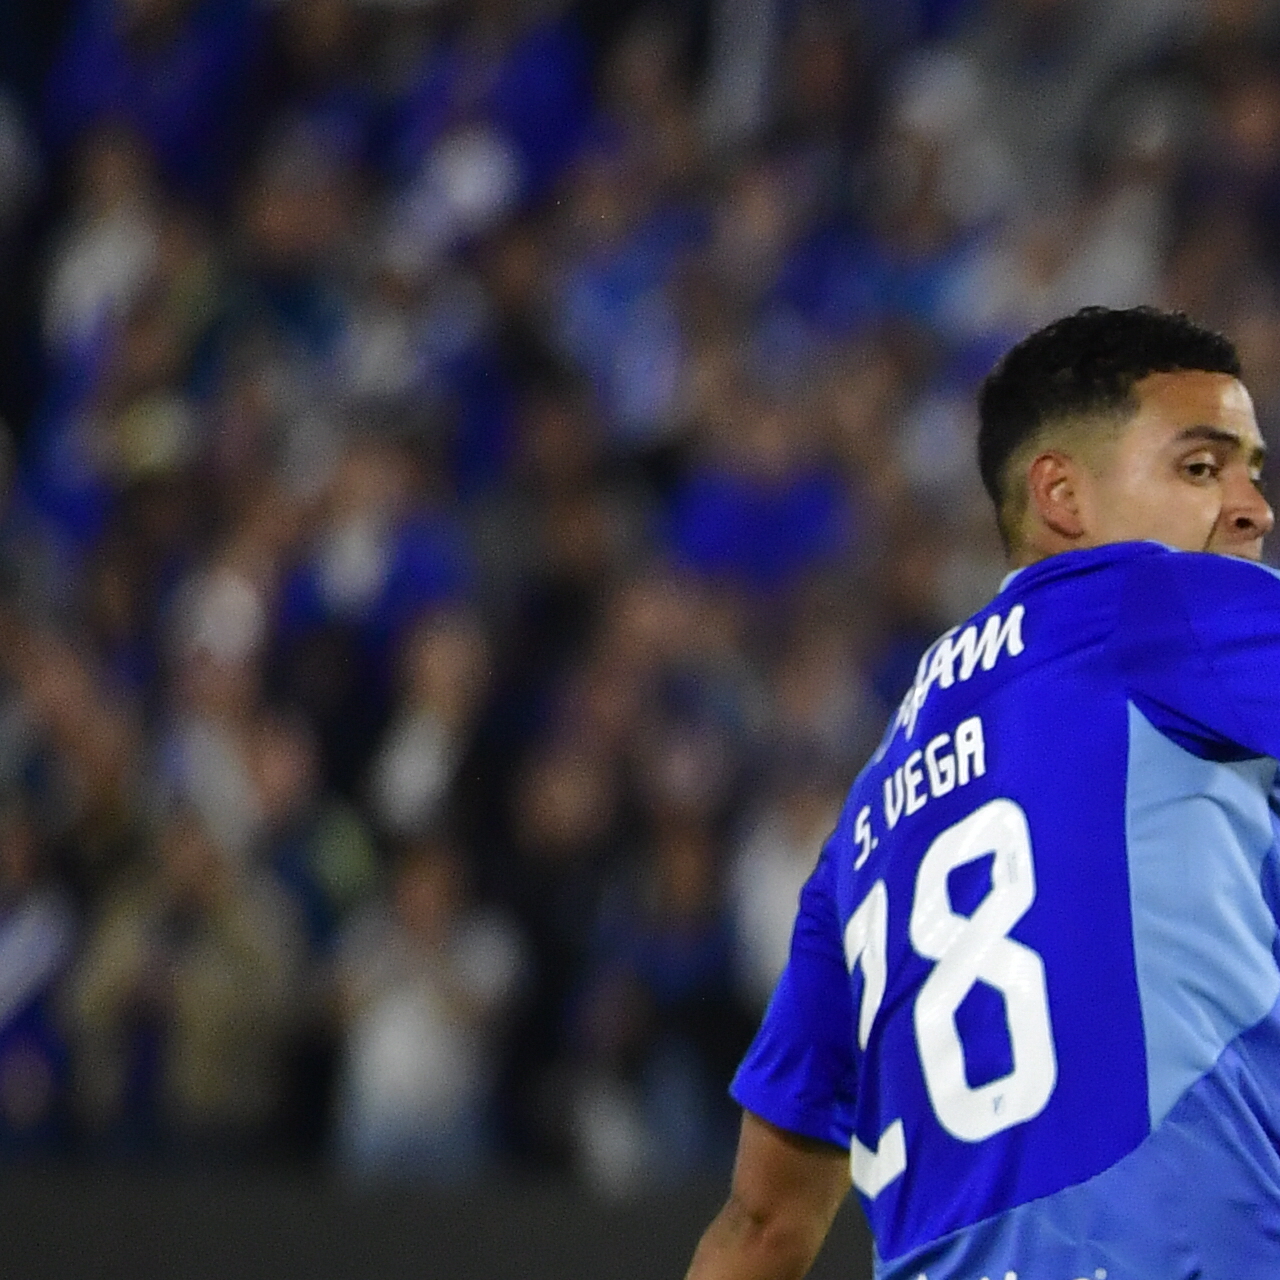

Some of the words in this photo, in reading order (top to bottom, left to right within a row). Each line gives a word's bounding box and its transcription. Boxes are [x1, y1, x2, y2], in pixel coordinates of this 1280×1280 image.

[854, 805, 879, 871] S.
[882, 716, 986, 831] VEGA
[843, 797, 1058, 1200] 28
